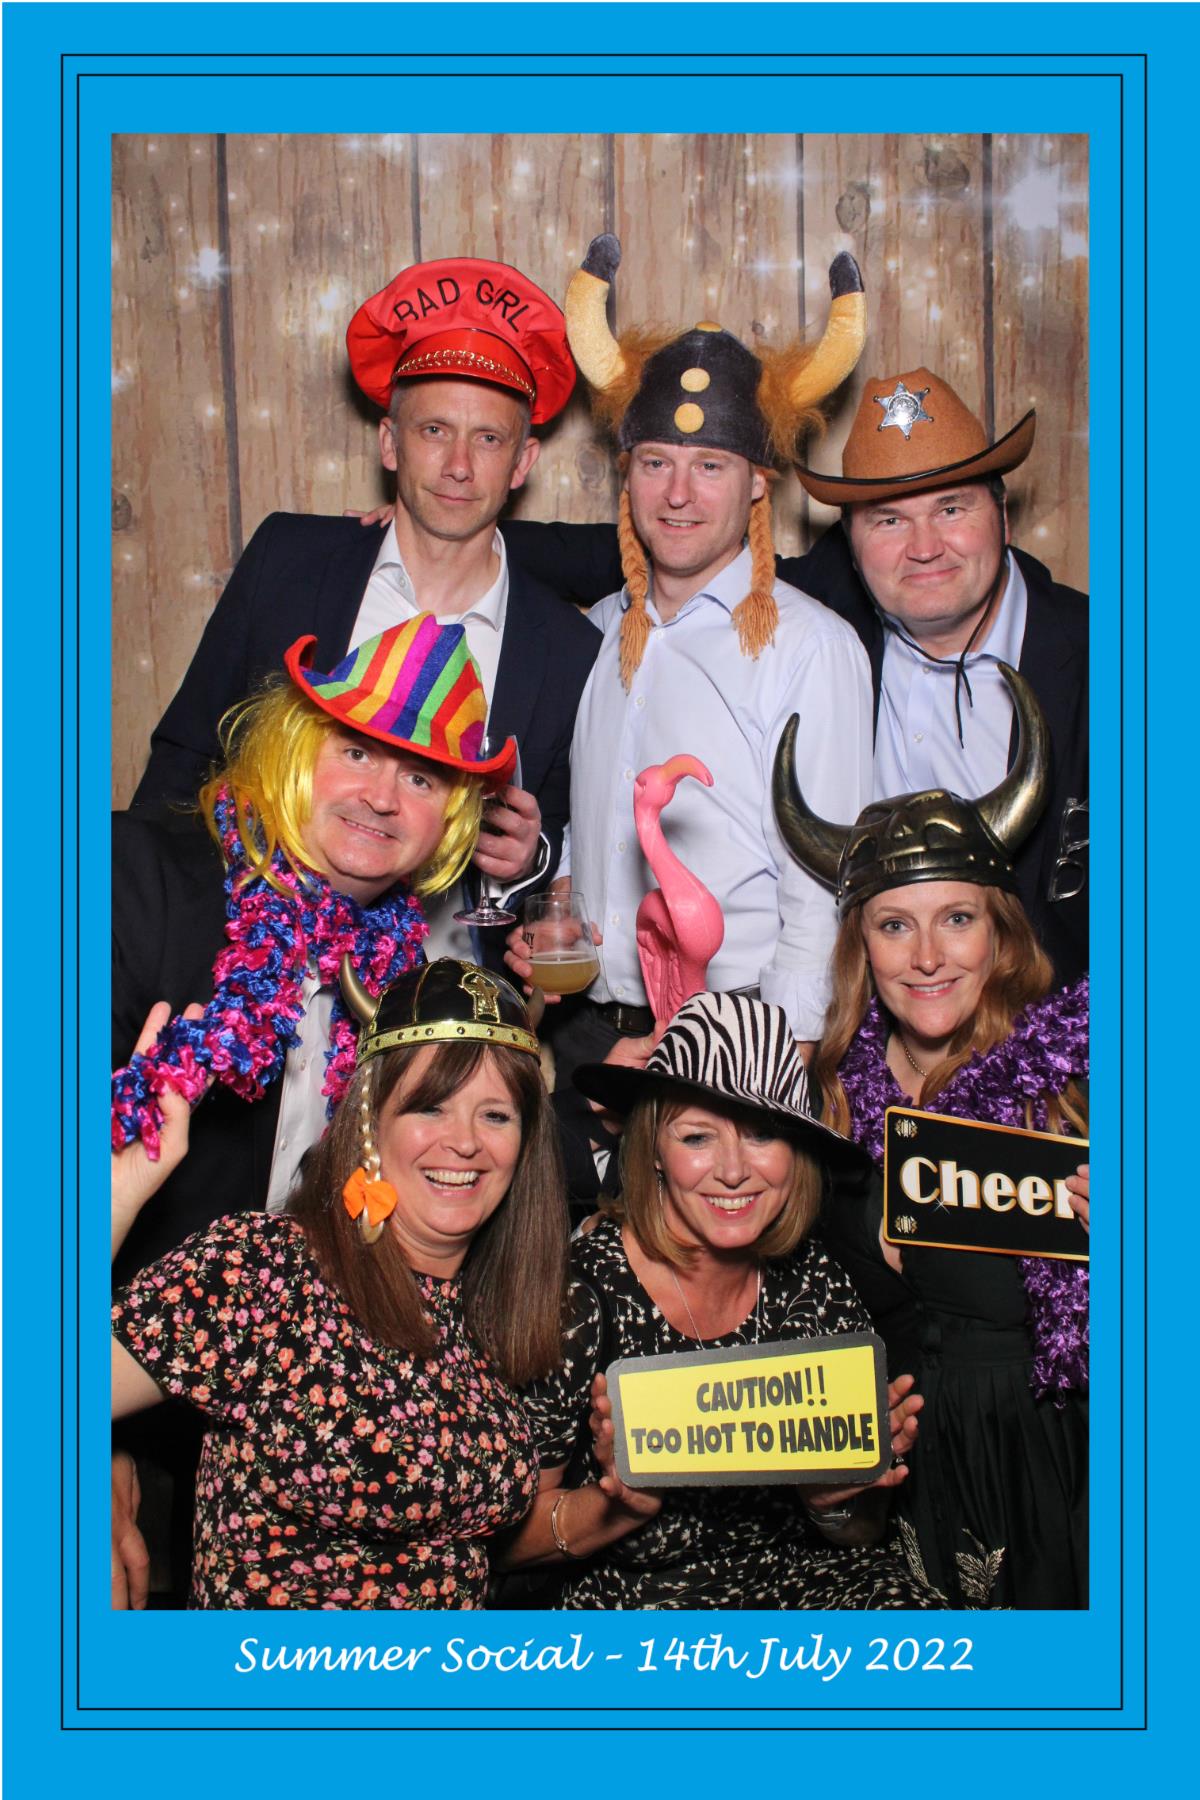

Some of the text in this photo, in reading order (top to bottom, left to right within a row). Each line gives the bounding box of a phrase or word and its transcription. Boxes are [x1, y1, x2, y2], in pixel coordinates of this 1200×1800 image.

[393, 278, 461, 322] BAD
[696, 1365, 828, 1413] CAUTION!!
[630, 1413, 875, 1455] TOO HOT TO HANDLE
